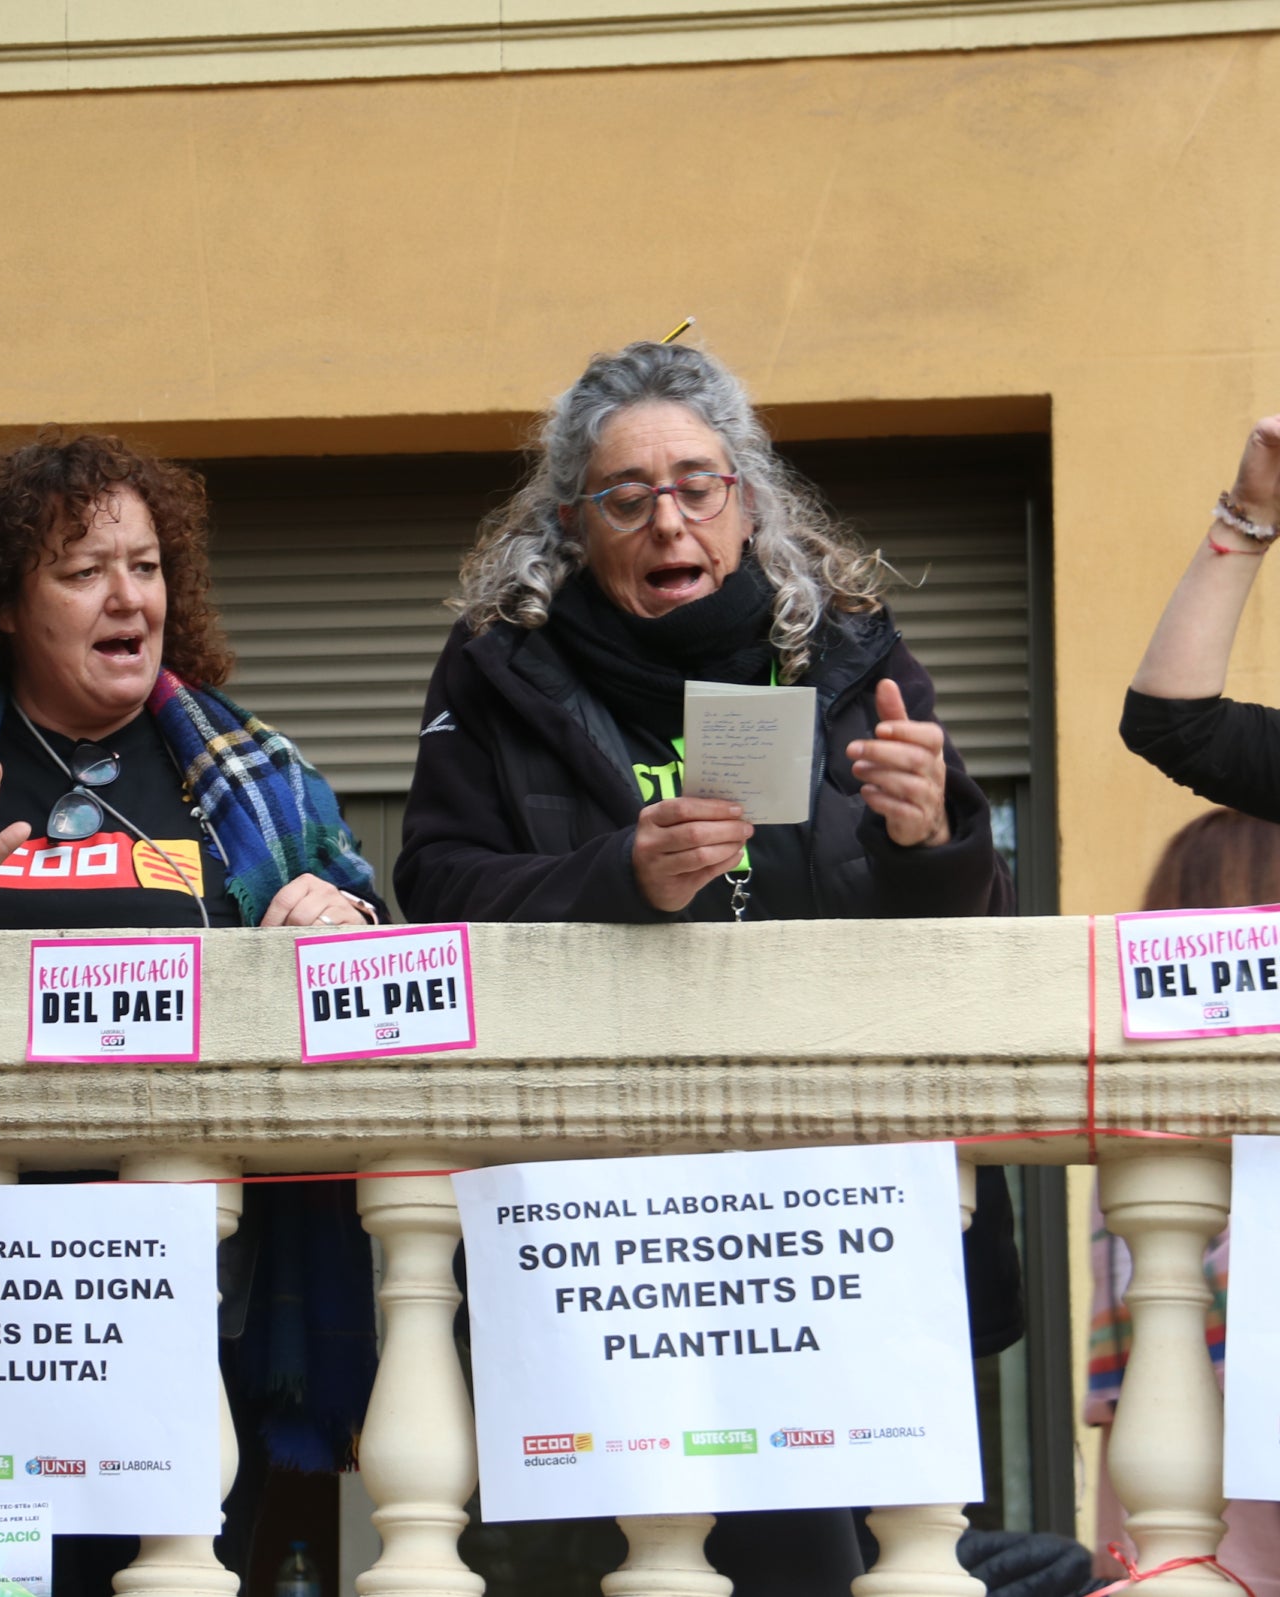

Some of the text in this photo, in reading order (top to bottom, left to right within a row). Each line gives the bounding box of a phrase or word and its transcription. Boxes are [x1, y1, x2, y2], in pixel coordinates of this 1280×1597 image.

[39, 952, 188, 990] RECLASSIFICACIÓ
[307, 939, 457, 989] RECLASSIFICACIÓ
[1134, 963, 1197, 999] DEL
[42, 990, 184, 1023] DEL PAE!
[312, 977, 457, 1022] DEL PAE!
[1204, 1007, 1229, 1019] CGT
[101, 1036, 125, 1046] CGT
[376, 1028, 399, 1039] CGT
[497, 1186, 903, 1225] PERSONAL LABORAL DOCENT:
[51, 1239, 166, 1258] DOCENT:
[519, 1227, 894, 1271] SOM PERSONES NO
[75, 1278, 174, 1300] DIGNA
[556, 1274, 861, 1314] FRAGMENTS DE
[33, 1323, 73, 1345] DE
[85, 1323, 123, 1344] LA
[605, 1326, 820, 1361] PLANTILLA
[786, 1430, 832, 1446] JUNTS
[849, 1427, 925, 1439] CGT LABORALS
[526, 1437, 570, 1450] CCOO
[628, 1439, 656, 1451] UGT
[40, 1460, 84, 1474] JUNTS
[99, 1461, 171, 1471] CGT LABORALS
[524, 1455, 577, 1466] educació
